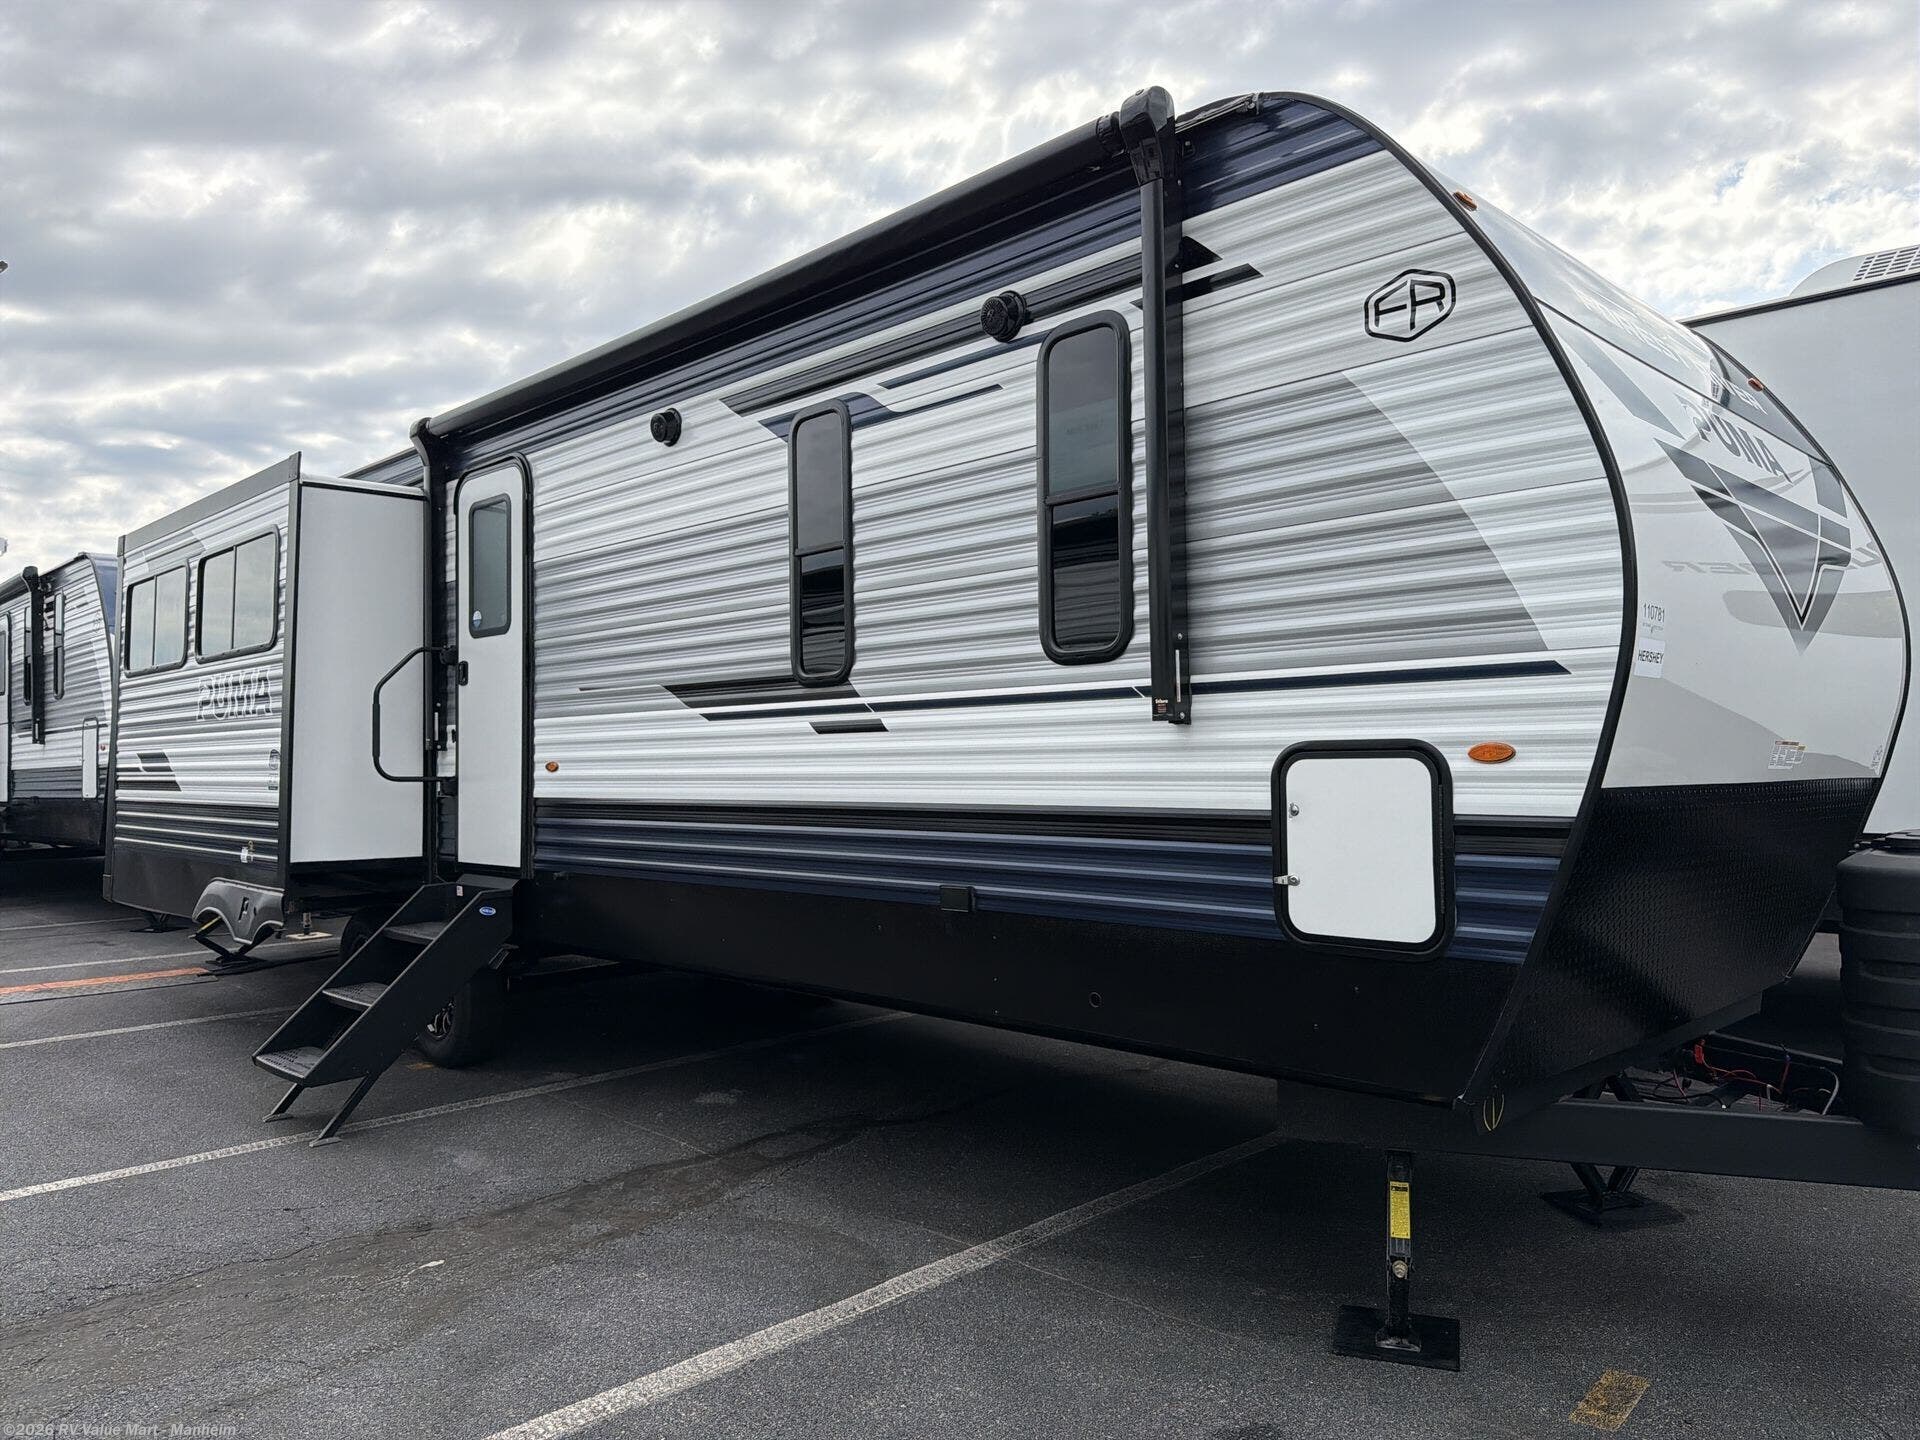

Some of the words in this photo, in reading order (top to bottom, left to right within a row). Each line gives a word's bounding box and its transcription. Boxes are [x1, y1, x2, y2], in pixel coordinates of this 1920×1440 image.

[1673, 392, 1793, 487] PUMA
[1637, 649, 1664, 664] HERSHEY
[196, 668, 273, 721] PUMA
